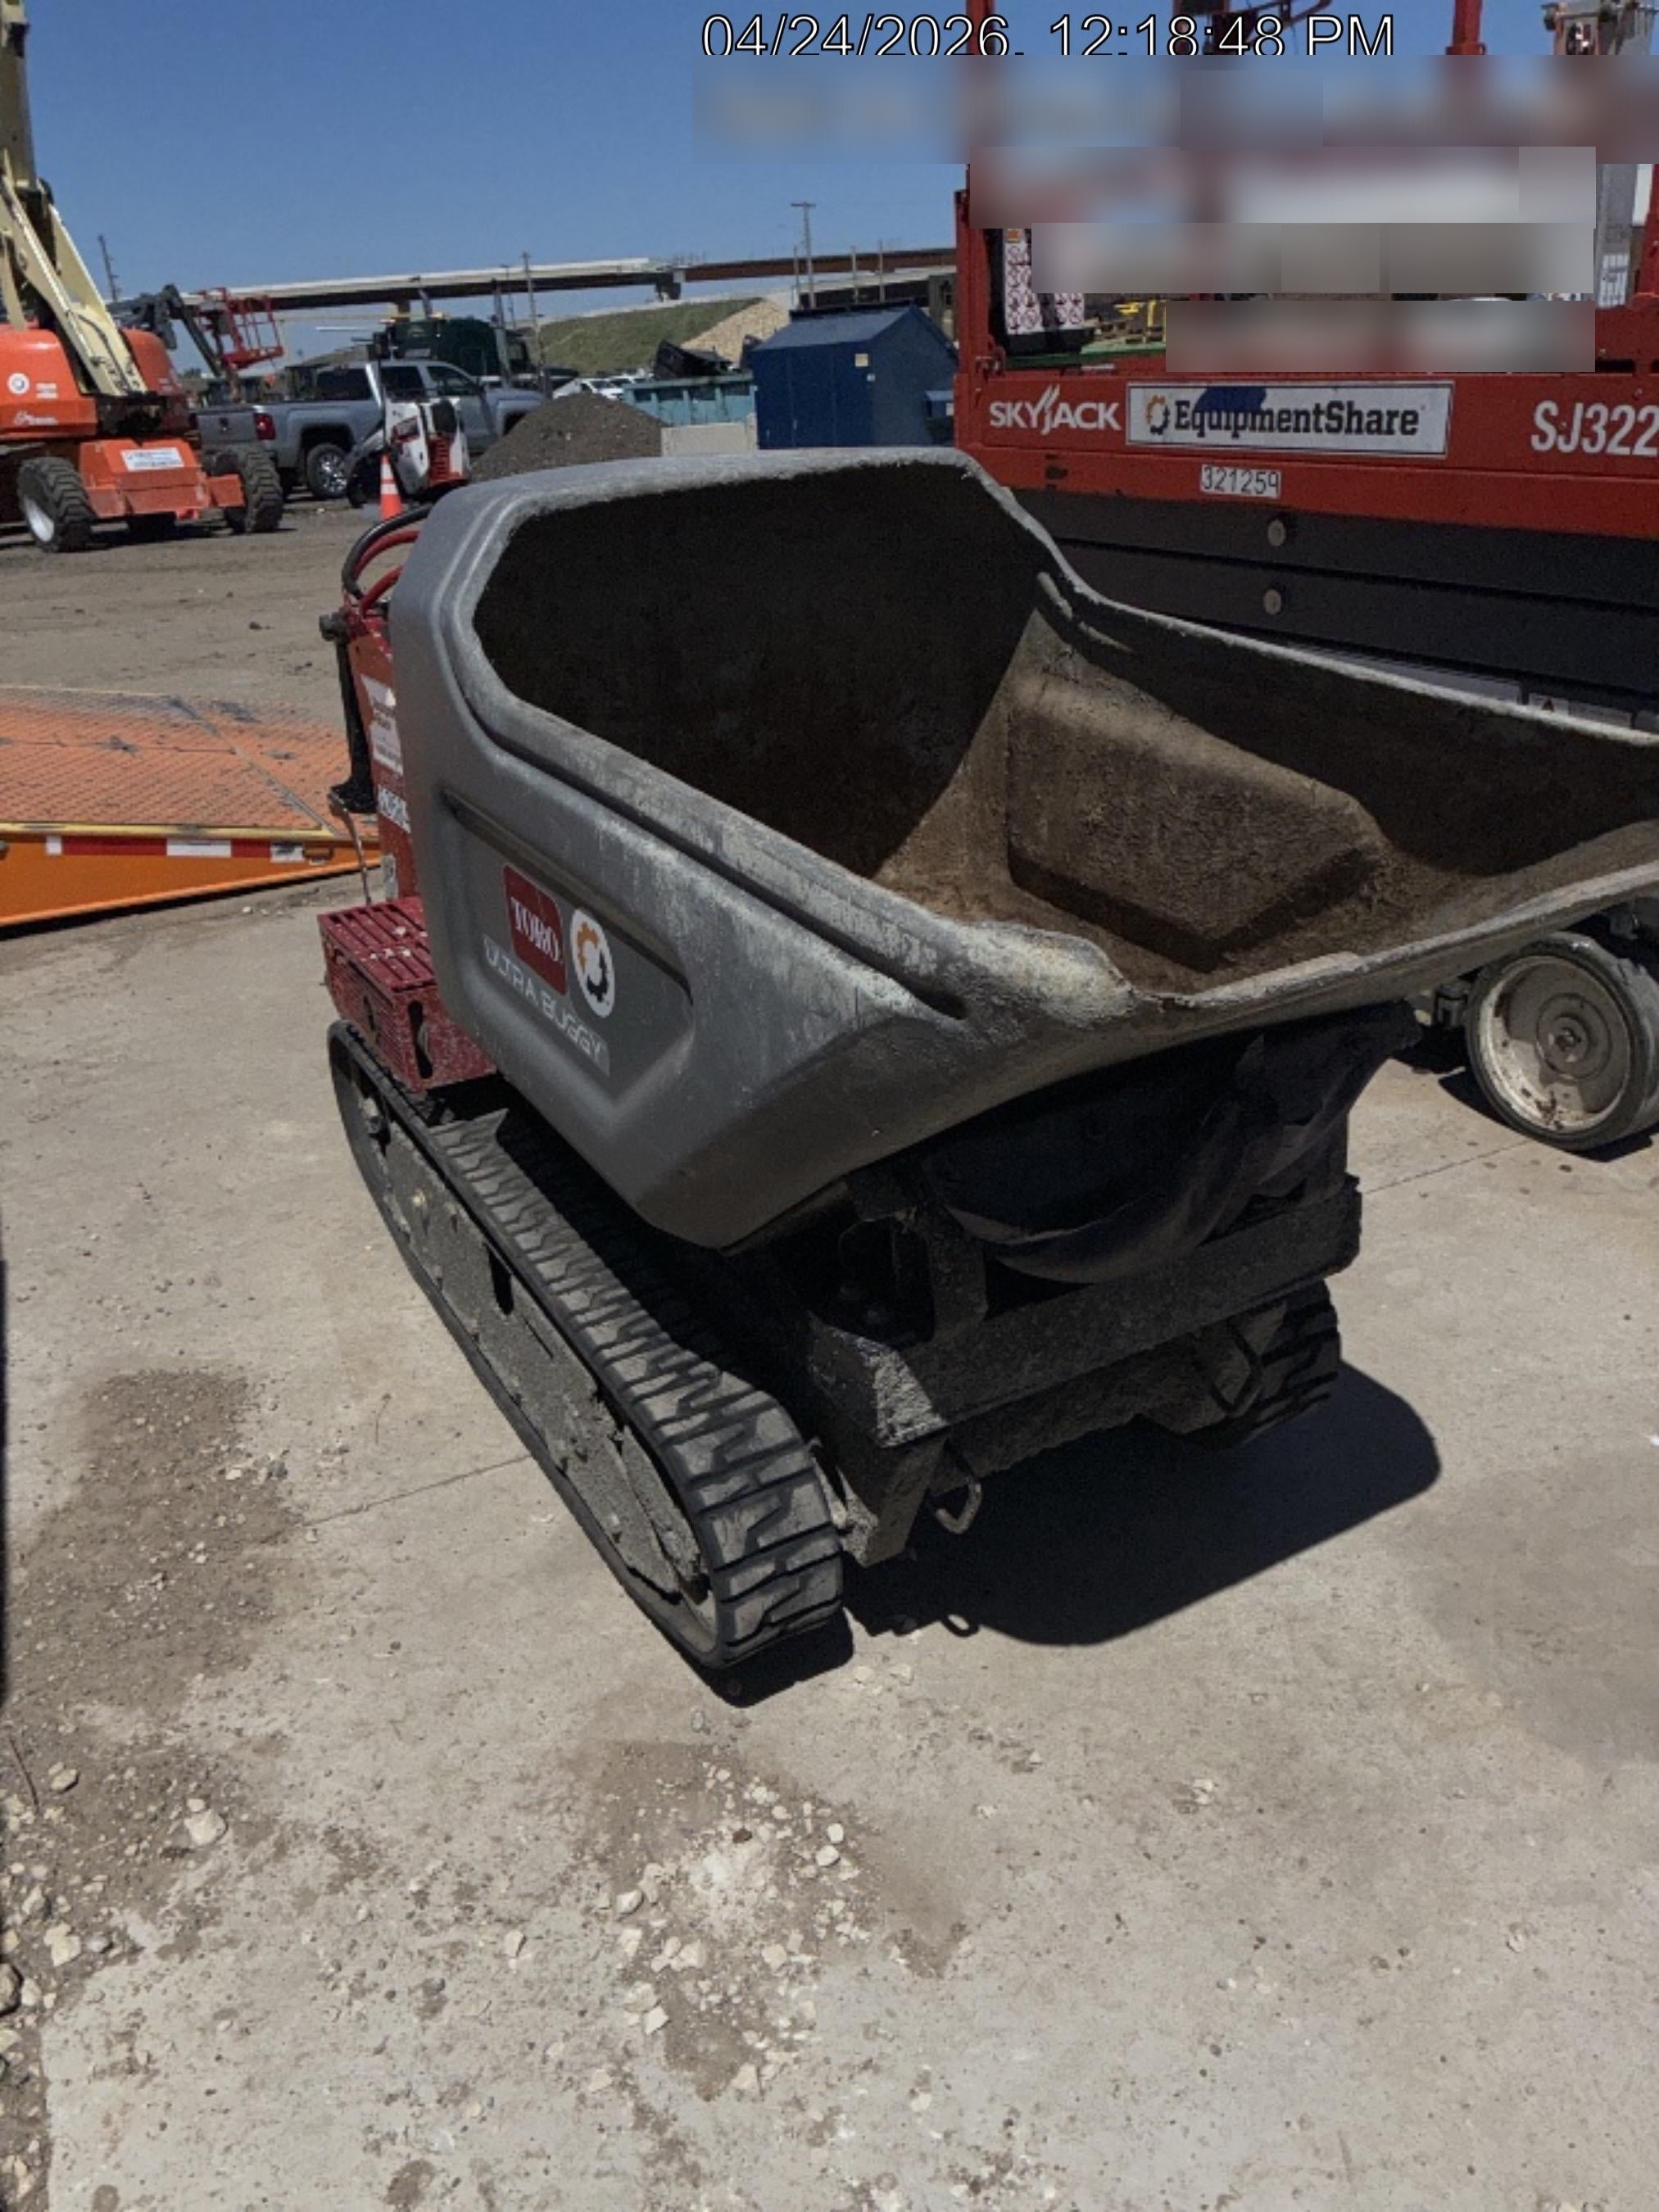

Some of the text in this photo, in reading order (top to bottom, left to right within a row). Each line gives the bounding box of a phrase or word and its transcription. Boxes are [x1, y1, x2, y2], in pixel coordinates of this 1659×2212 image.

[989, 383, 1122, 436] SKYJACK
[1174, 400, 1420, 439] EquipmentShare
[1201, 466, 1279, 496] 321259
[510, 895, 560, 962] TORO
[483, 939, 603, 1063] ULTRA BUGGY
